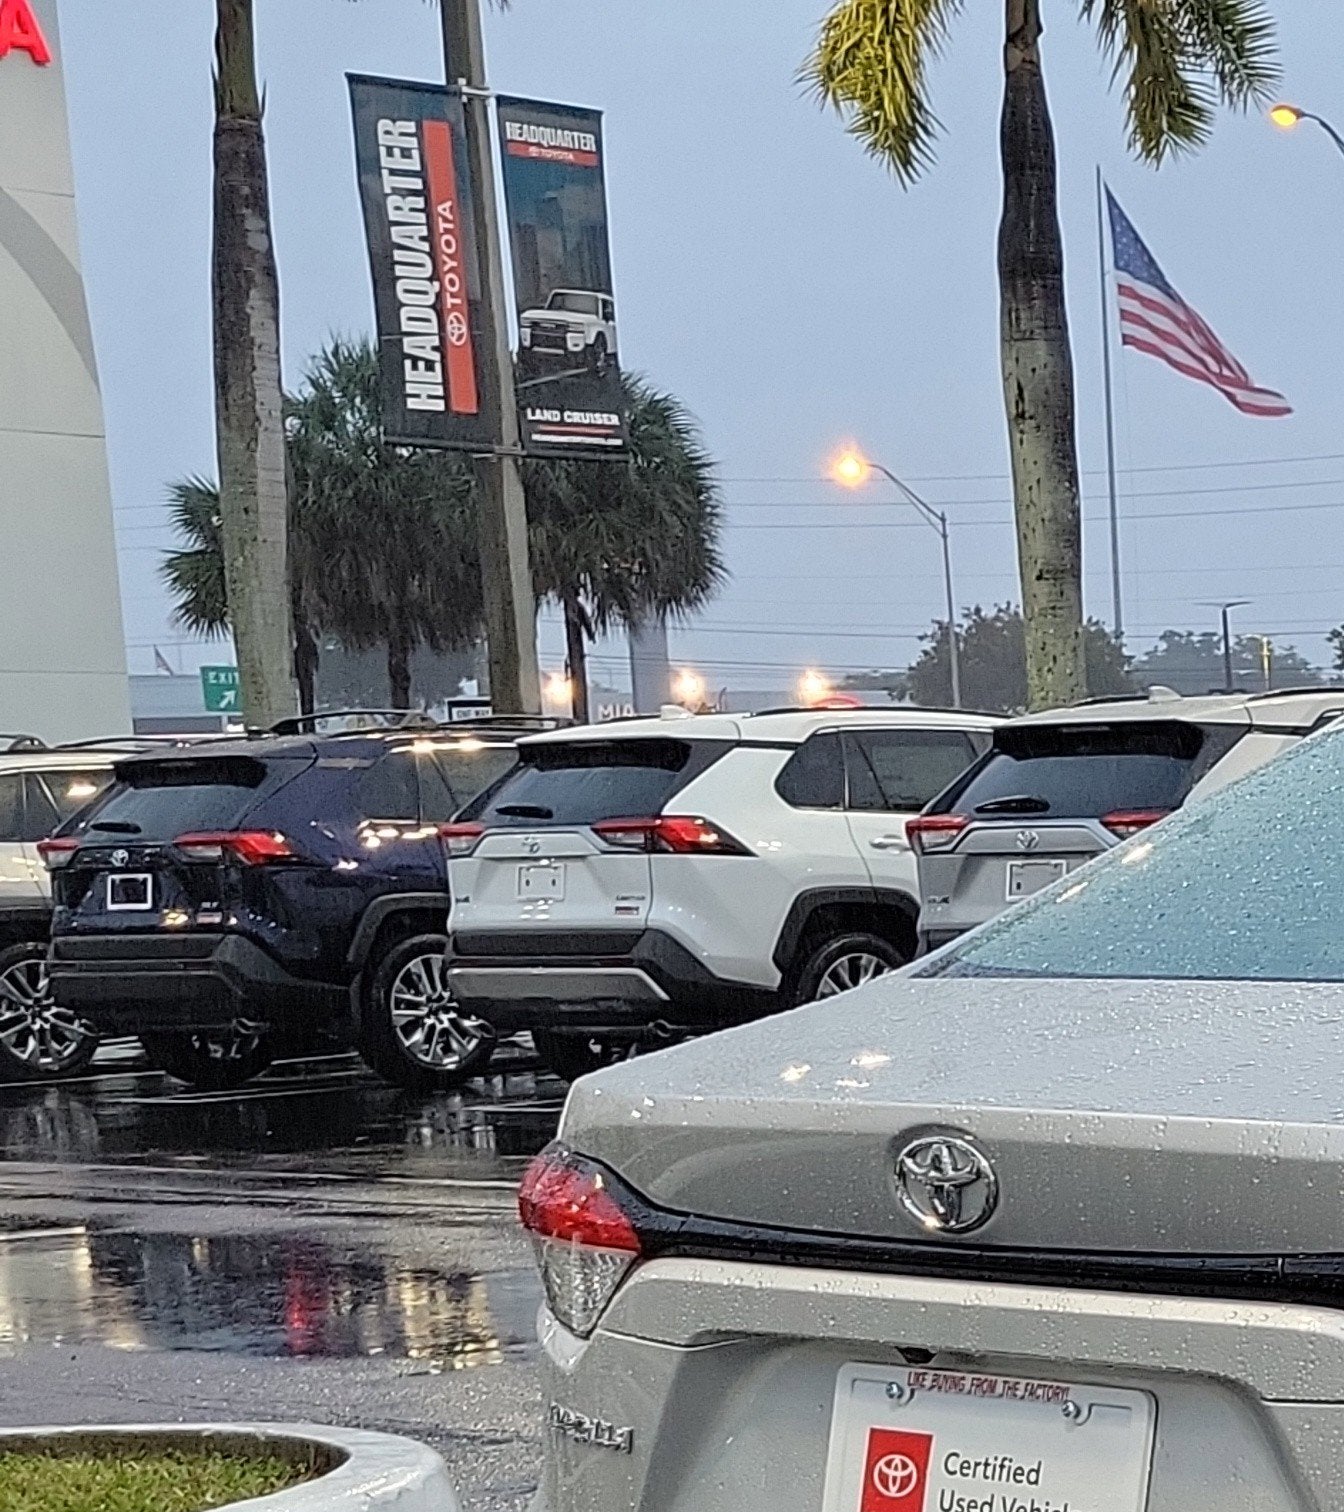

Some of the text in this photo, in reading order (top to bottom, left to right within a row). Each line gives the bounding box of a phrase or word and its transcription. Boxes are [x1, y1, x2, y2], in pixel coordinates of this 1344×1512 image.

[505, 121, 597, 153] HEADQUARTER
[377, 118, 446, 412] HEADQUARTER
[437, 200, 461, 308] TOYOTA
[526, 407, 620, 426] LAND CRUISER
[907, 1371, 928, 1388] LIKE
[929, 1373, 967, 1393] BUYING
[967, 1377, 998, 1396] FROM
[999, 1380, 1022, 1399] THE
[943, 1452, 1042, 1486] Certified
